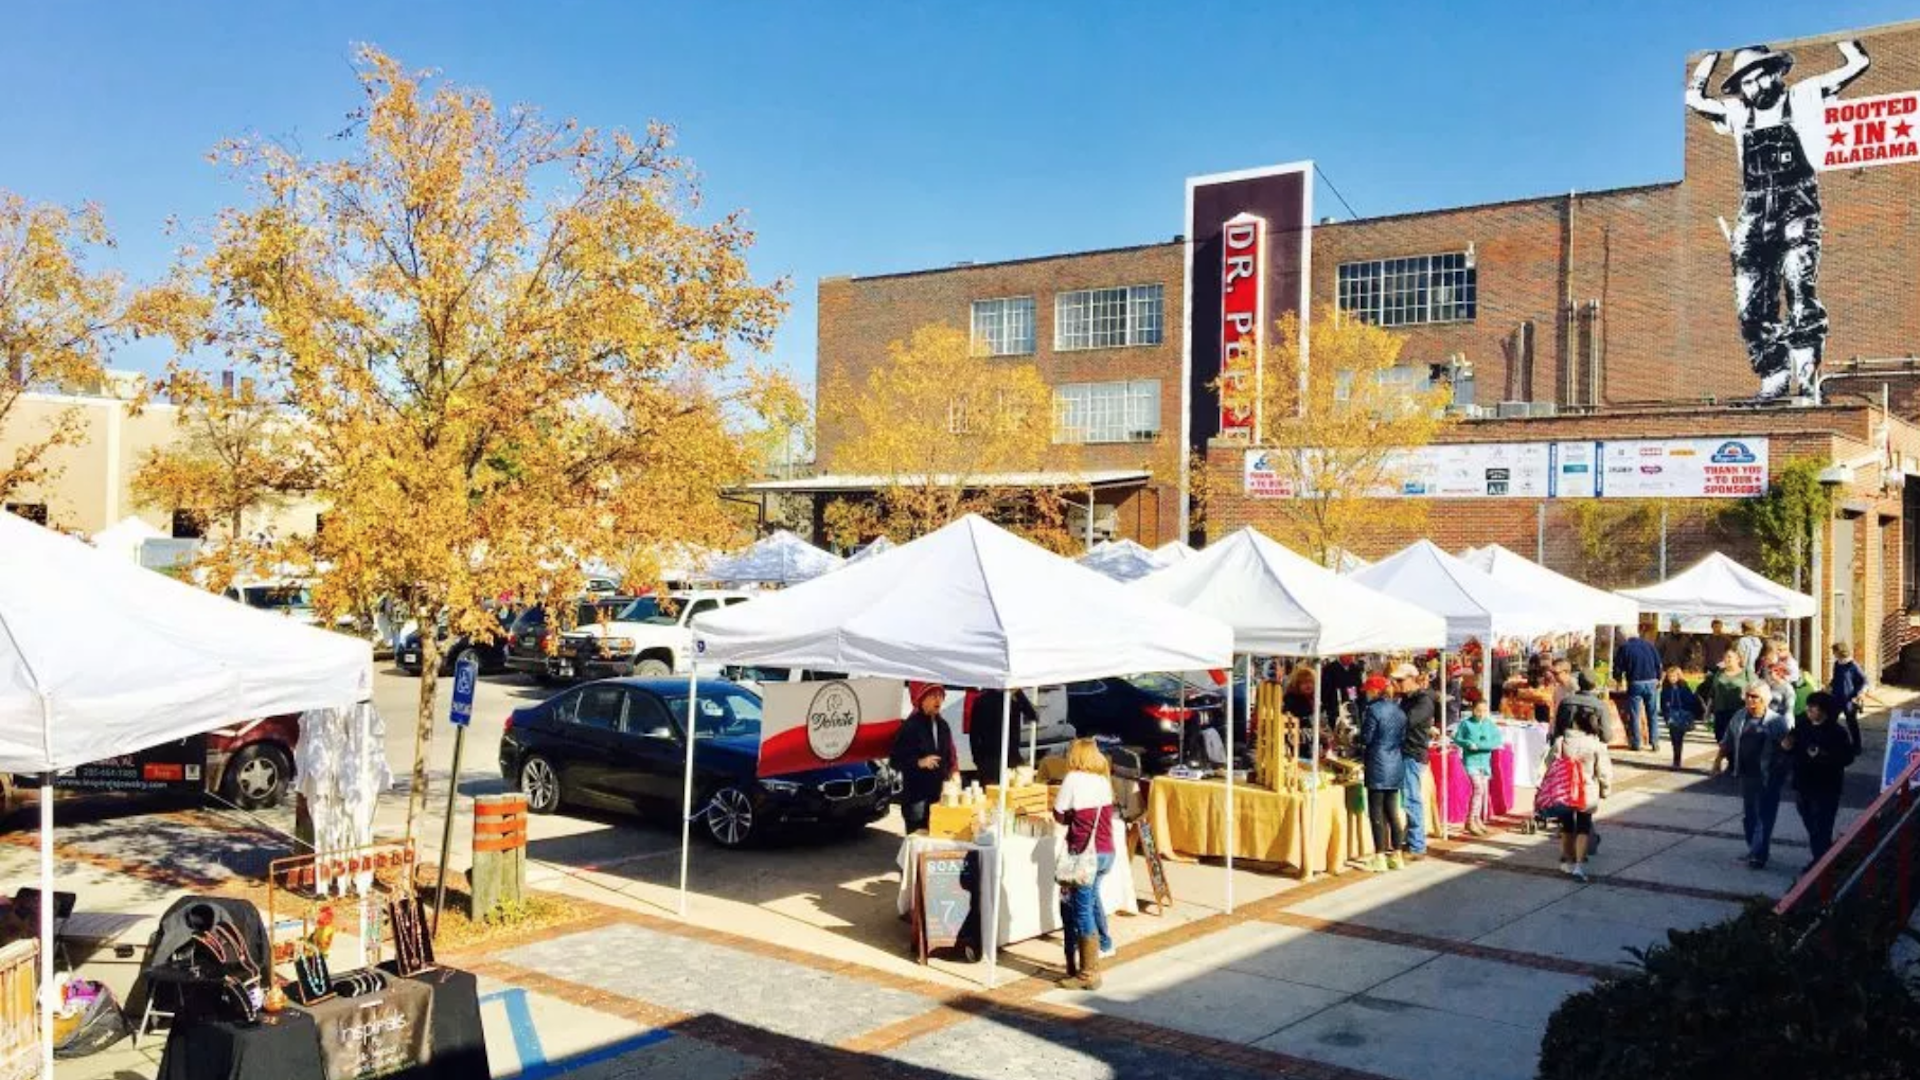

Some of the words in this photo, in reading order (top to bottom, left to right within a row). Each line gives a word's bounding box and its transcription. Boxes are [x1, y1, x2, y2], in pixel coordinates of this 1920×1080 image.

[1825, 96, 1917, 124] ROOTED
[1854, 121, 1886, 145] IN
[1825, 142, 1918, 165] ALABAMA
[1226, 225, 1255, 293] DR.
[1703, 466, 1738, 475] THANK
[1741, 465, 1763, 474] YOU
[1714, 476, 1729, 484] TO
[1732, 476, 1753, 484] OUR
[1703, 485, 1762, 494] SPONSORS
